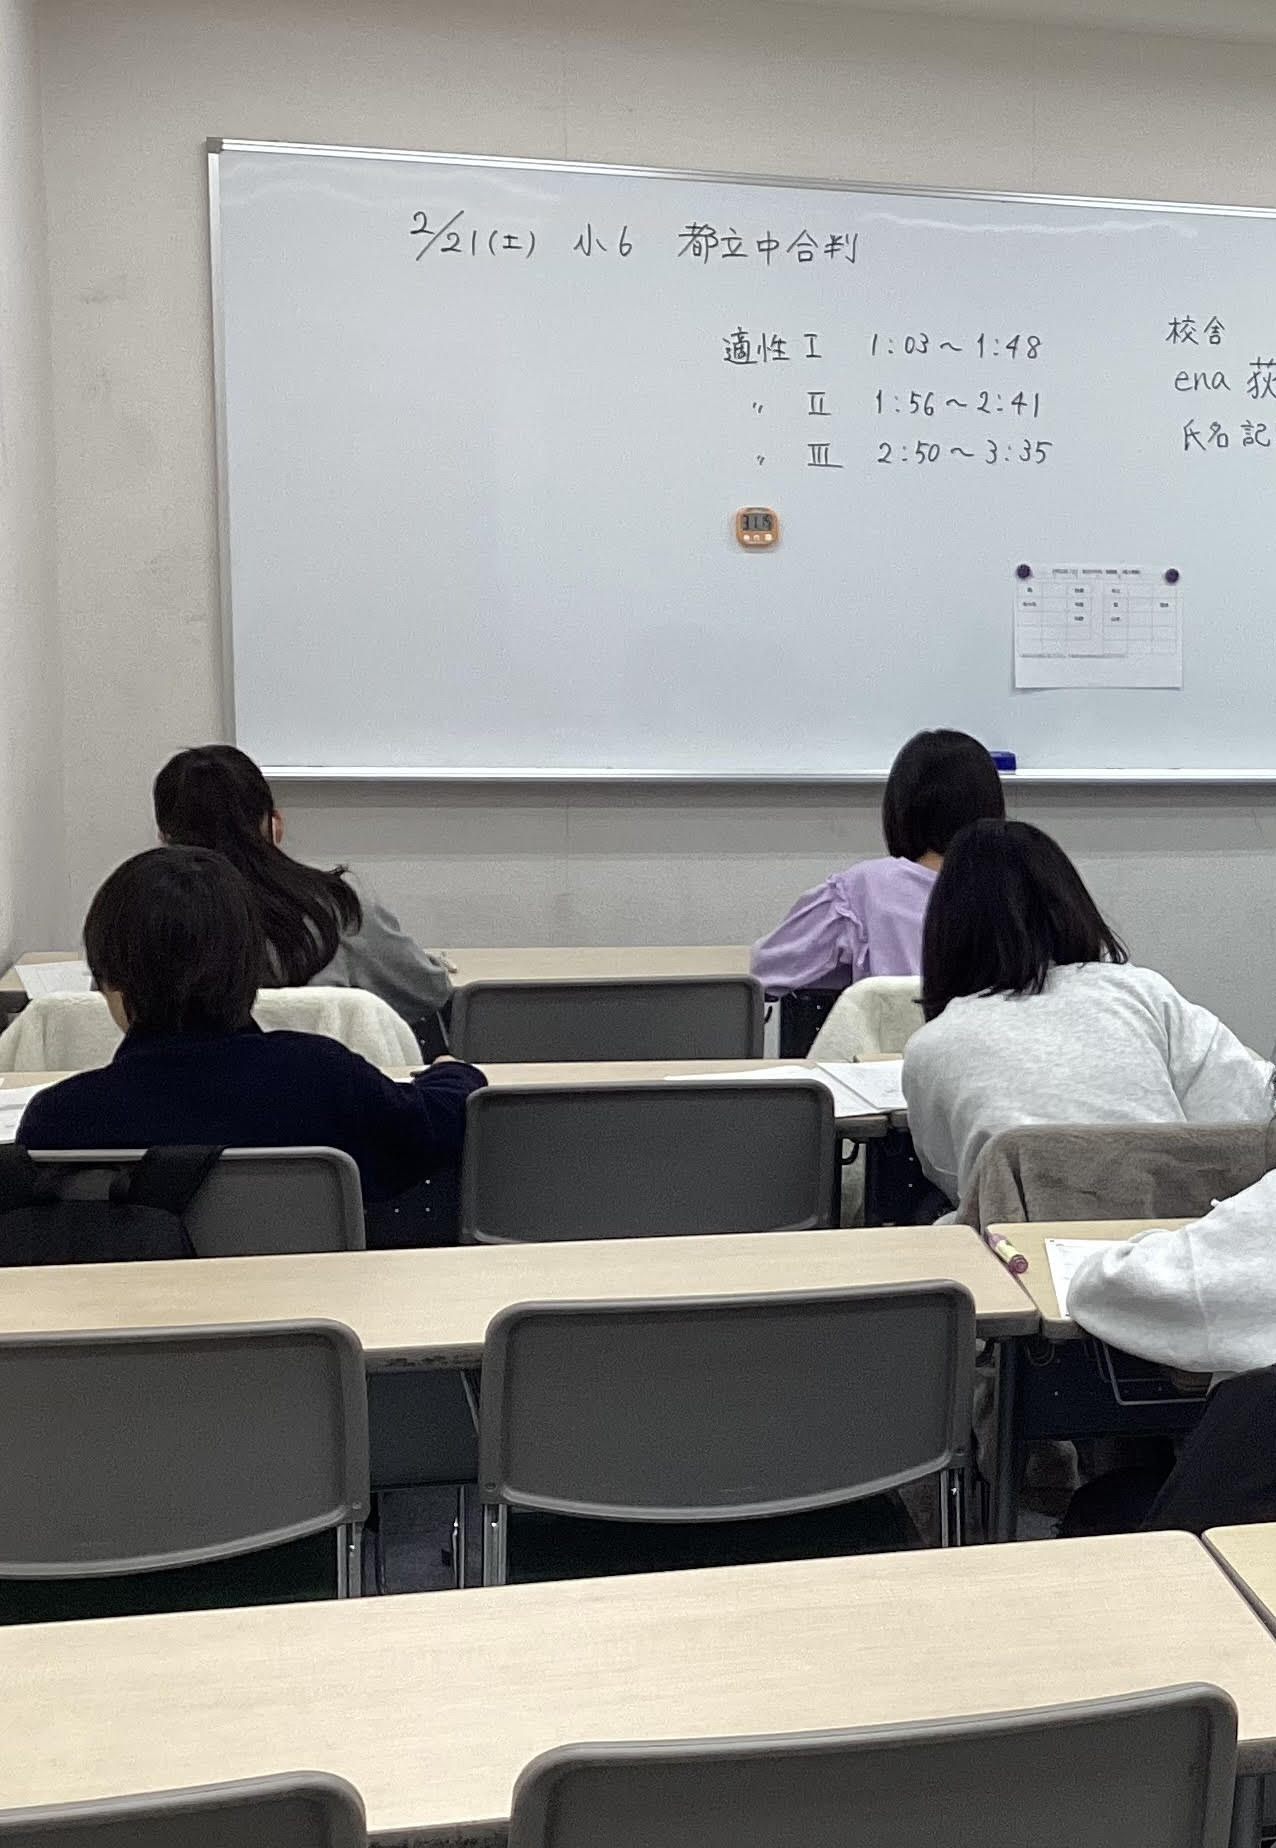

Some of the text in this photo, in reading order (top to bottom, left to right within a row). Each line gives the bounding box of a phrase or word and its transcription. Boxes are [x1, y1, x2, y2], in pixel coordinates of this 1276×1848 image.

[573, 222, 633, 258] 小6
[677, 221, 857, 266] 都立中合判
[1165, 314, 1226, 346] 校舎
[1174, 370, 1232, 392] ena
